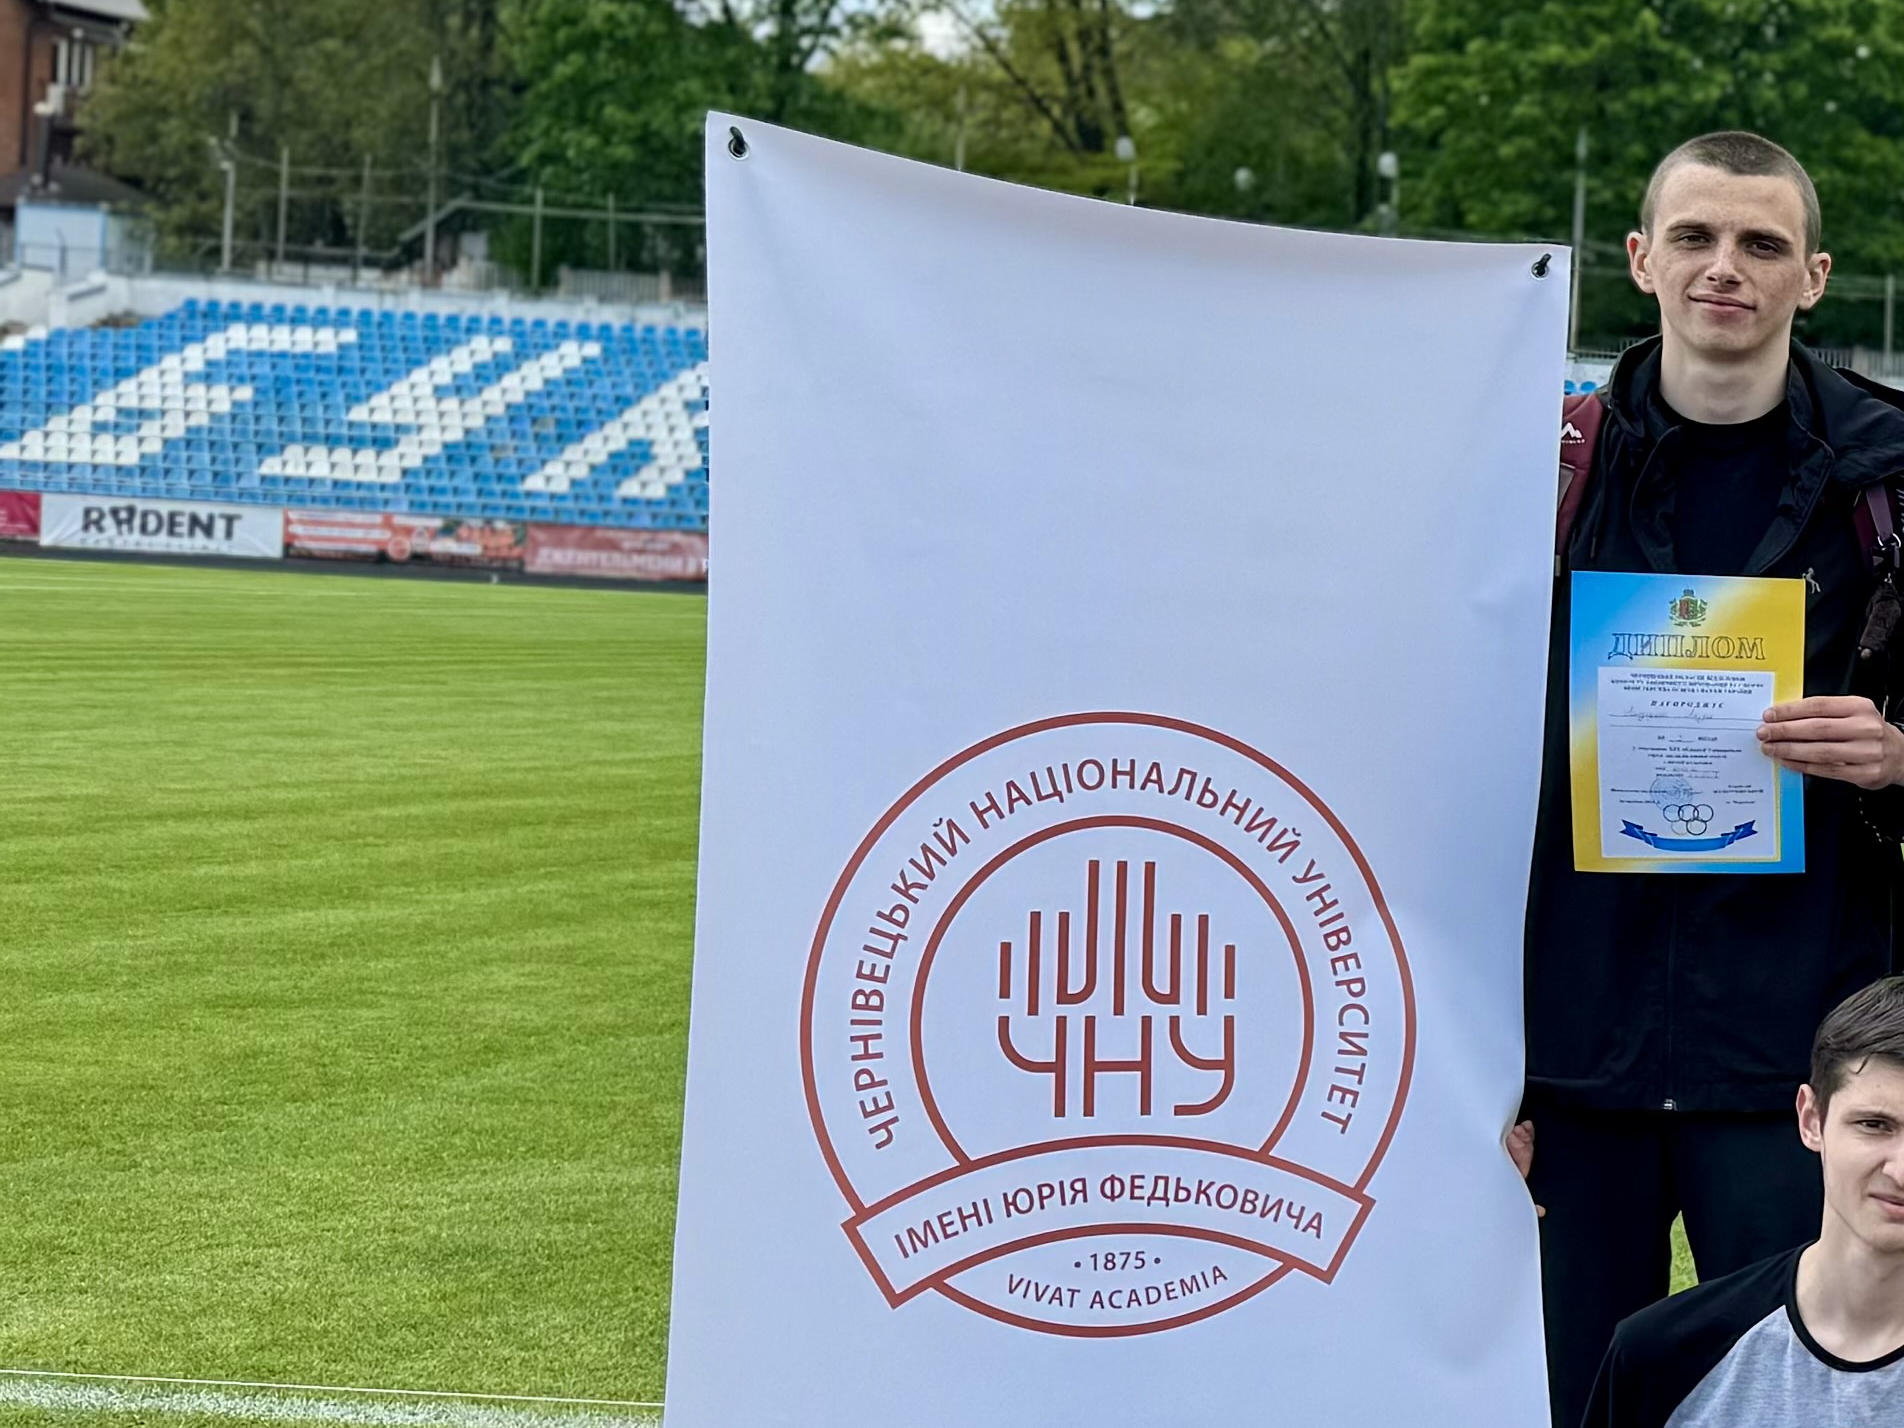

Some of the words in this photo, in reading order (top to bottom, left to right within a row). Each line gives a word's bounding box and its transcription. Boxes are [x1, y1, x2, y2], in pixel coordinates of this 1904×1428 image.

[1607, 632, 1767, 661] ДИПЛОМ
[849, 816, 971, 1152] ЧЕРНІВЕЦЬКИЙ
[969, 758, 1302, 866] НАЦІОНАЛЬНИЙ
[1291, 858, 1370, 1136] УНІВЕРСИТЕТ
[998, 1012, 1237, 1118] ЧНУ
[893, 1196, 995, 1260] ІМЕНІ
[1003, 1176, 1090, 1220] ЮРІЯ
[1099, 1173, 1325, 1239] ФЕДЬКОВИЧА
[1005, 1272, 1081, 1310] VIVAT
[1089, 1264, 1229, 1310] ACADEMIA
[1089, 1250, 1147, 1273] 1875
